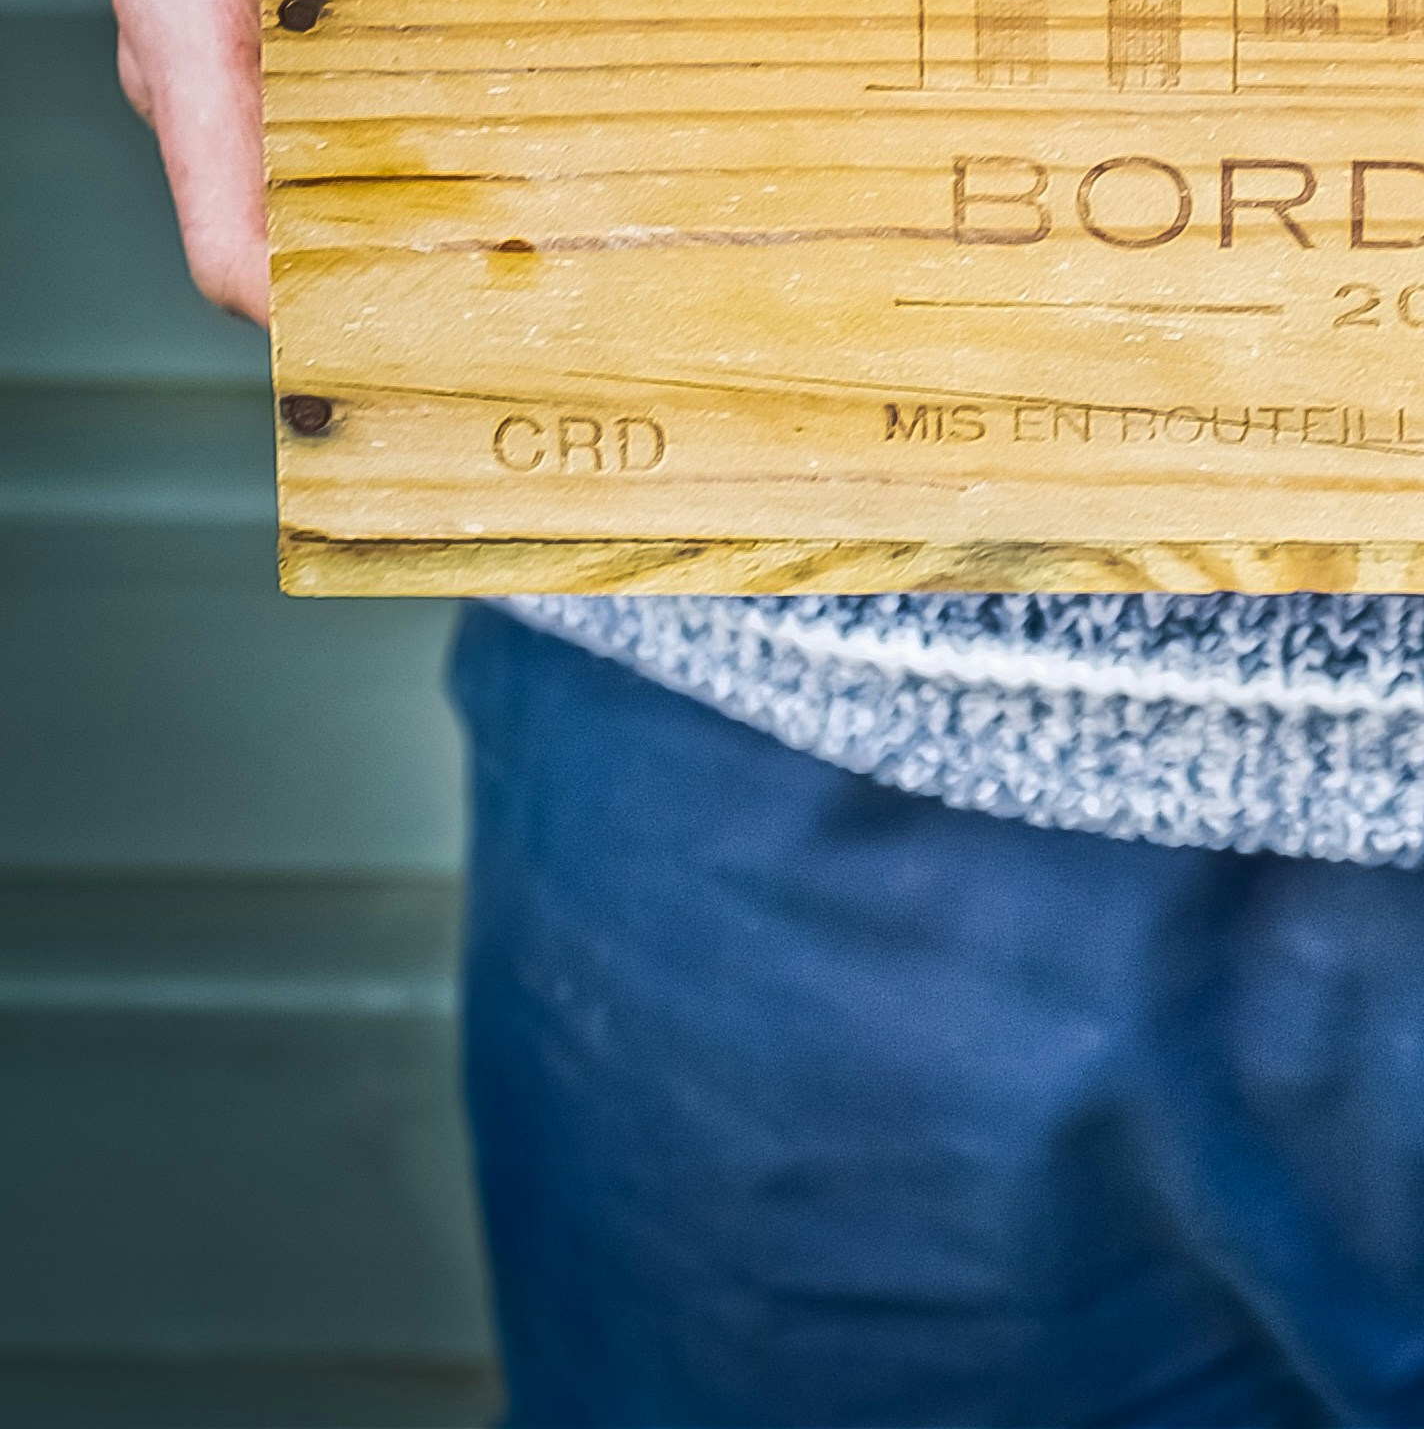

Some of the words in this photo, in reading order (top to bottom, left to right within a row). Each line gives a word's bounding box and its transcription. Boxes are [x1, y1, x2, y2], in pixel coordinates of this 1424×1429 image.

[492, 414, 666, 473] CRD
[883, 402, 986, 443] MIS
[1012, 405, 1092, 442] EN
